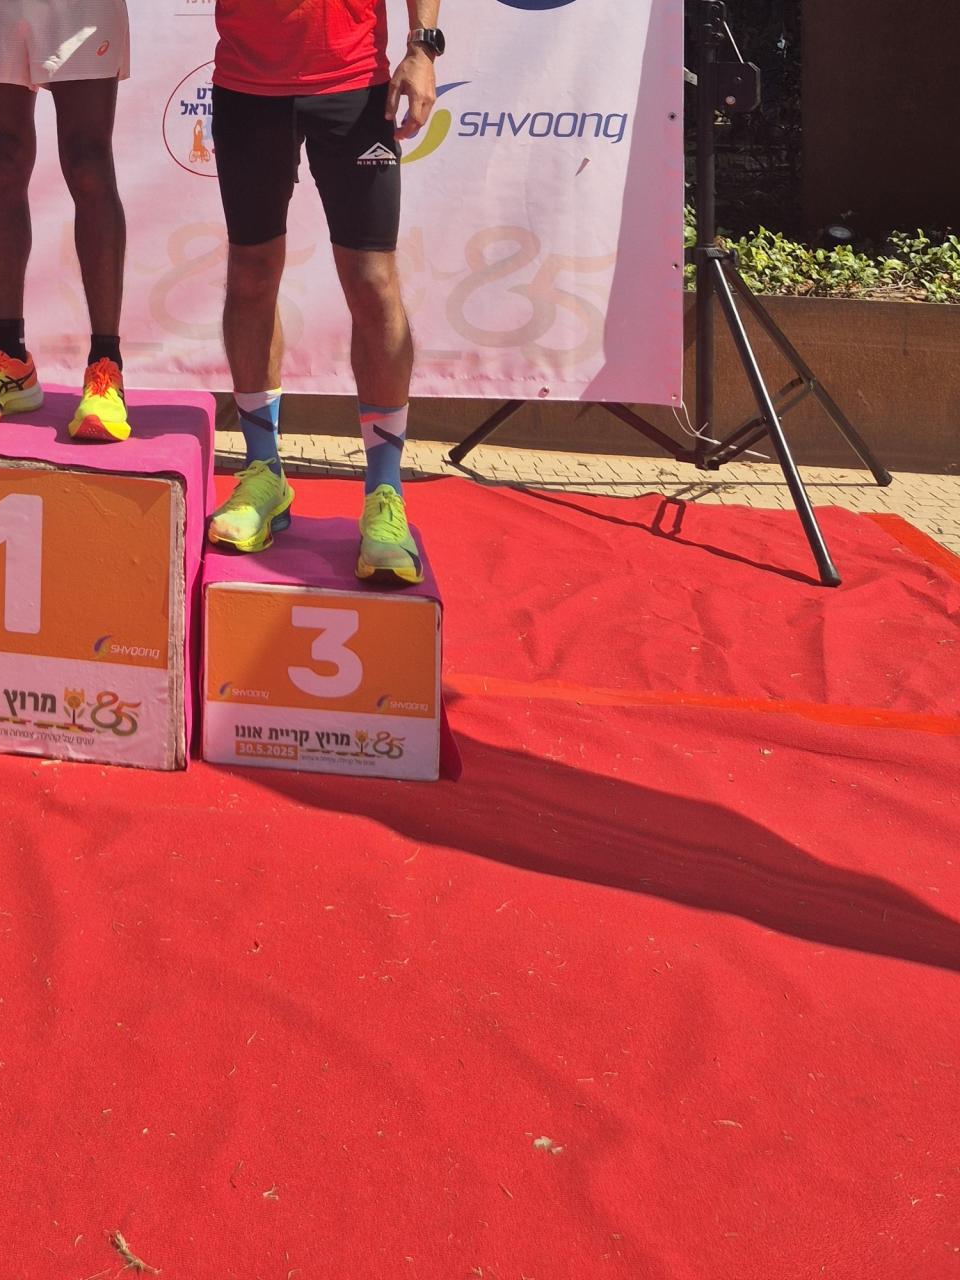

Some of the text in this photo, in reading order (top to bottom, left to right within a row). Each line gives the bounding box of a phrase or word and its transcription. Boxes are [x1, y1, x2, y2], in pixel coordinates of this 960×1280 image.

[287, 606, 364, 699] 3
[4, 688, 57, 717] מרוץ
[89, 690, 142, 737] 85
[234, 724, 351, 748] מרוץ קריית אונו
[239, 742, 295, 758] 30.5.2025
